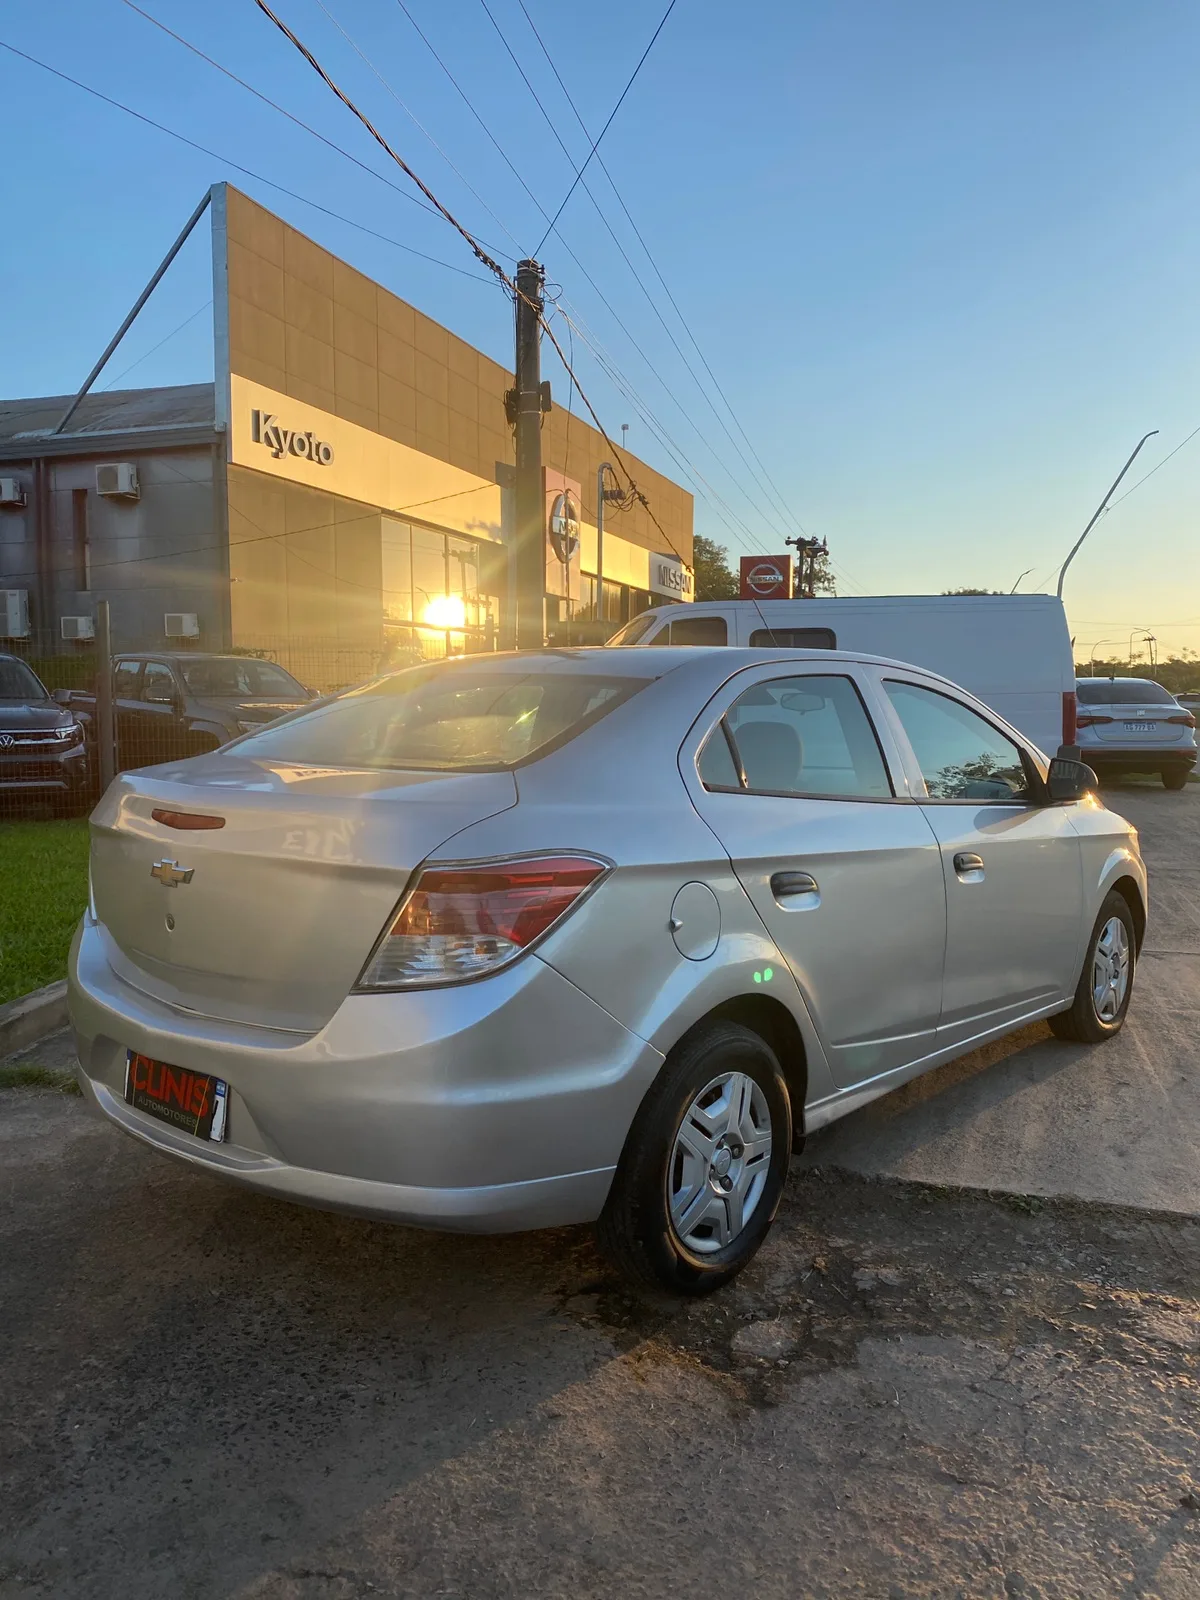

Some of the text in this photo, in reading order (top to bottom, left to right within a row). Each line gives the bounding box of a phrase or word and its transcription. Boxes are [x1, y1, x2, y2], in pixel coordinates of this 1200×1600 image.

[251, 409, 334, 466] Kyoto
[658, 564, 692, 594] NISSAN
[138, 1095, 199, 1128] AUTOMOTORES
